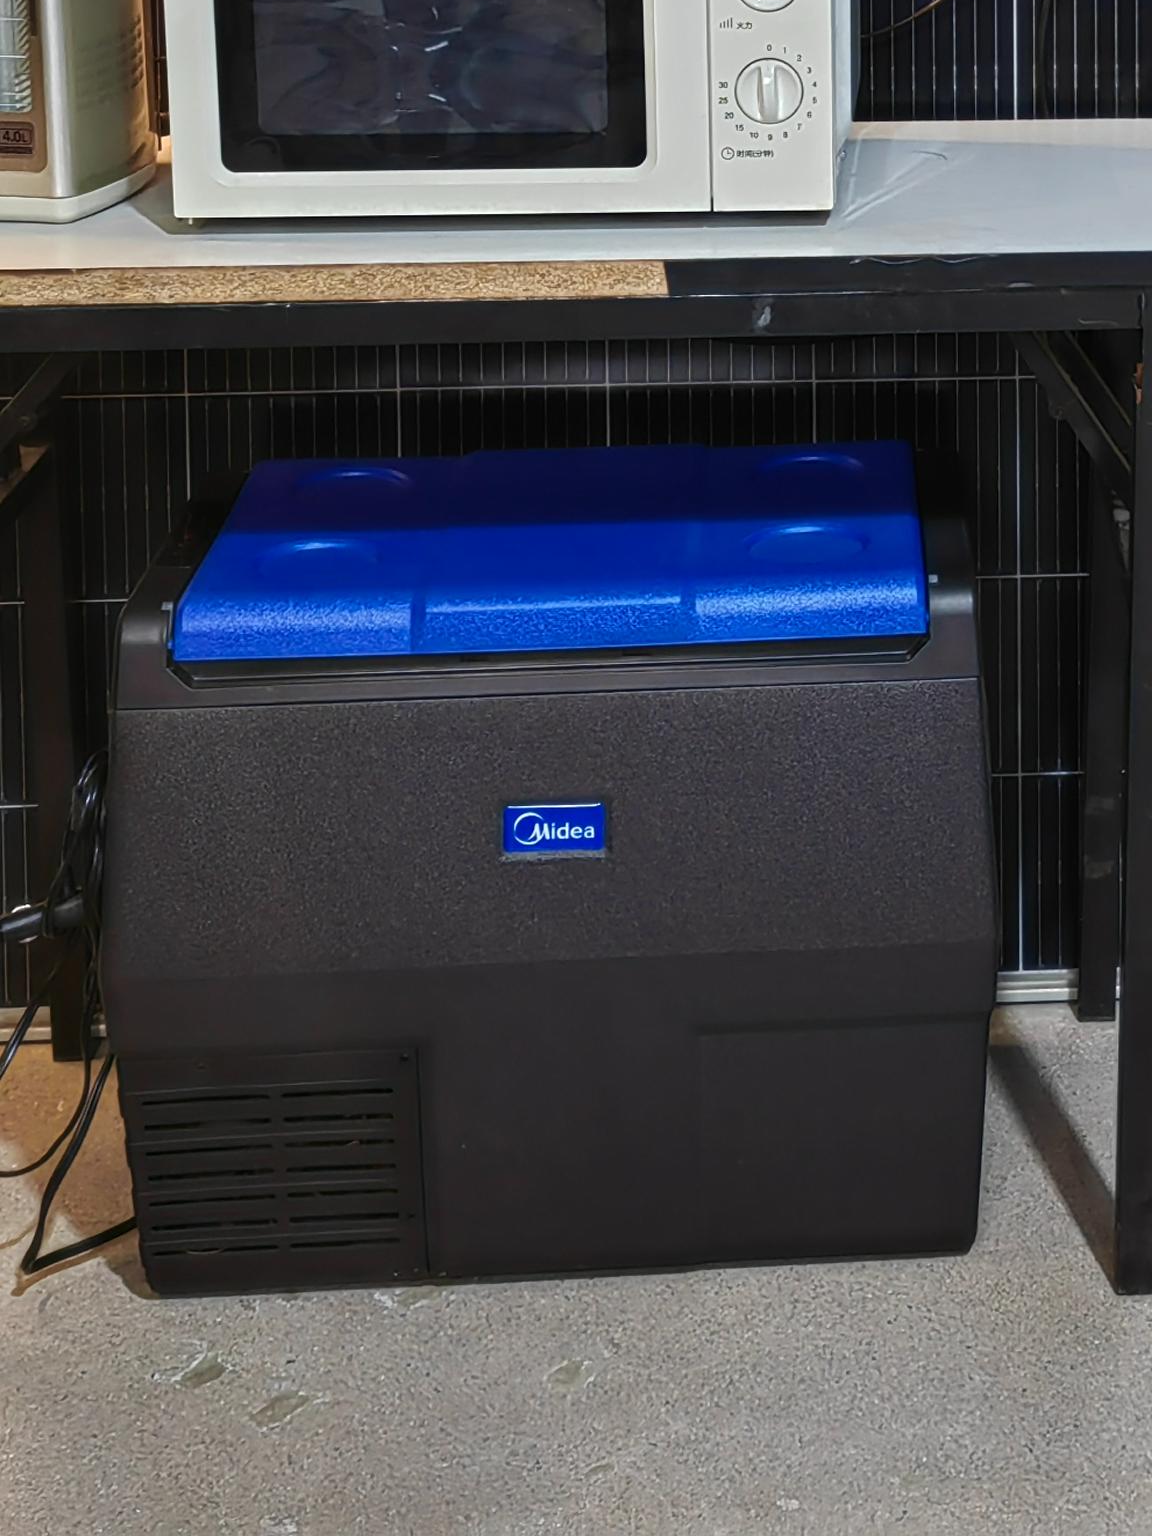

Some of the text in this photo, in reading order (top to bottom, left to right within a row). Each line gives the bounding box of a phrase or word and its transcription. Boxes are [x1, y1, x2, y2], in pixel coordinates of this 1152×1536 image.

[766, 44, 773, 52] 0
[797, 54, 802, 62] 2
[2, 130, 28, 143] 4.0L
[527, 821, 596, 840] Midea
